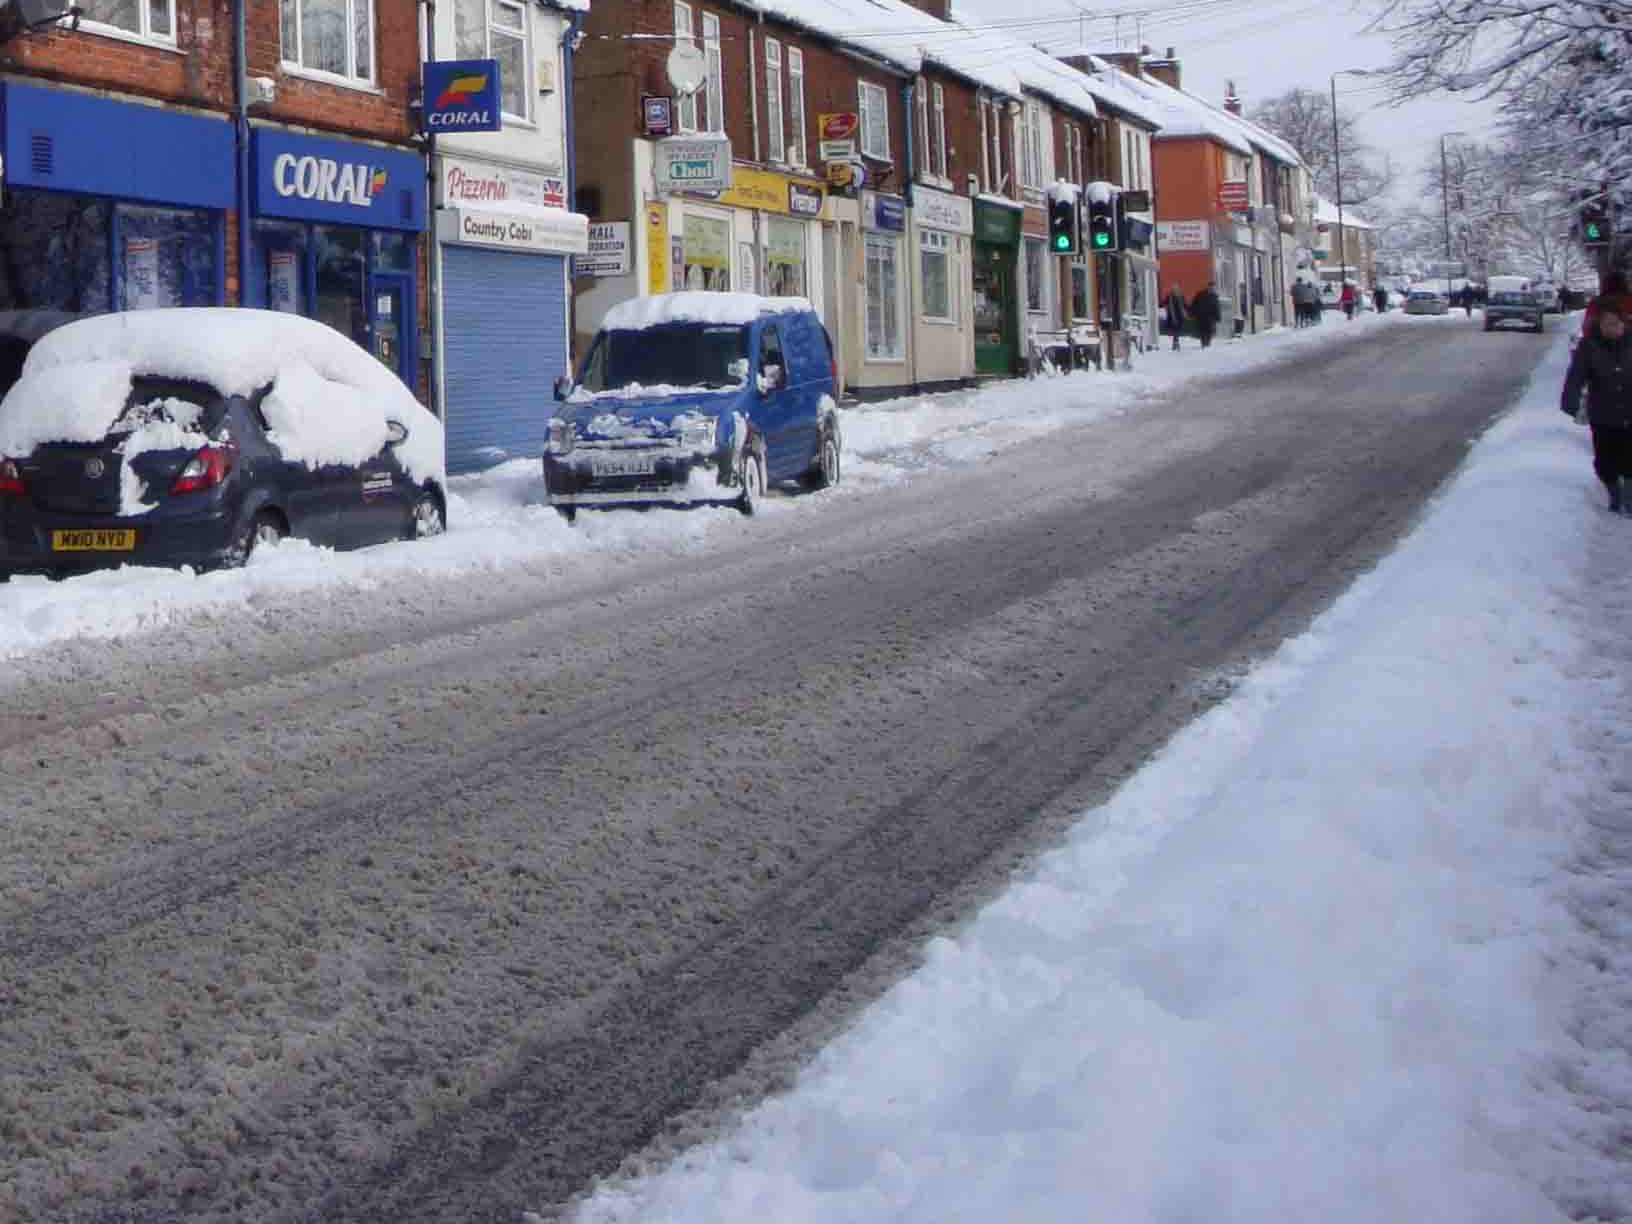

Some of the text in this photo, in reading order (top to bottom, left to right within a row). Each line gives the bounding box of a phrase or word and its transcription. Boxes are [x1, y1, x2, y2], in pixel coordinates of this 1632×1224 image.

[427, 111, 492, 126] CORAL
[273, 152, 372, 207] CORAL
[447, 166, 506, 201] Pizzeria
[463, 215, 506, 242] Country
